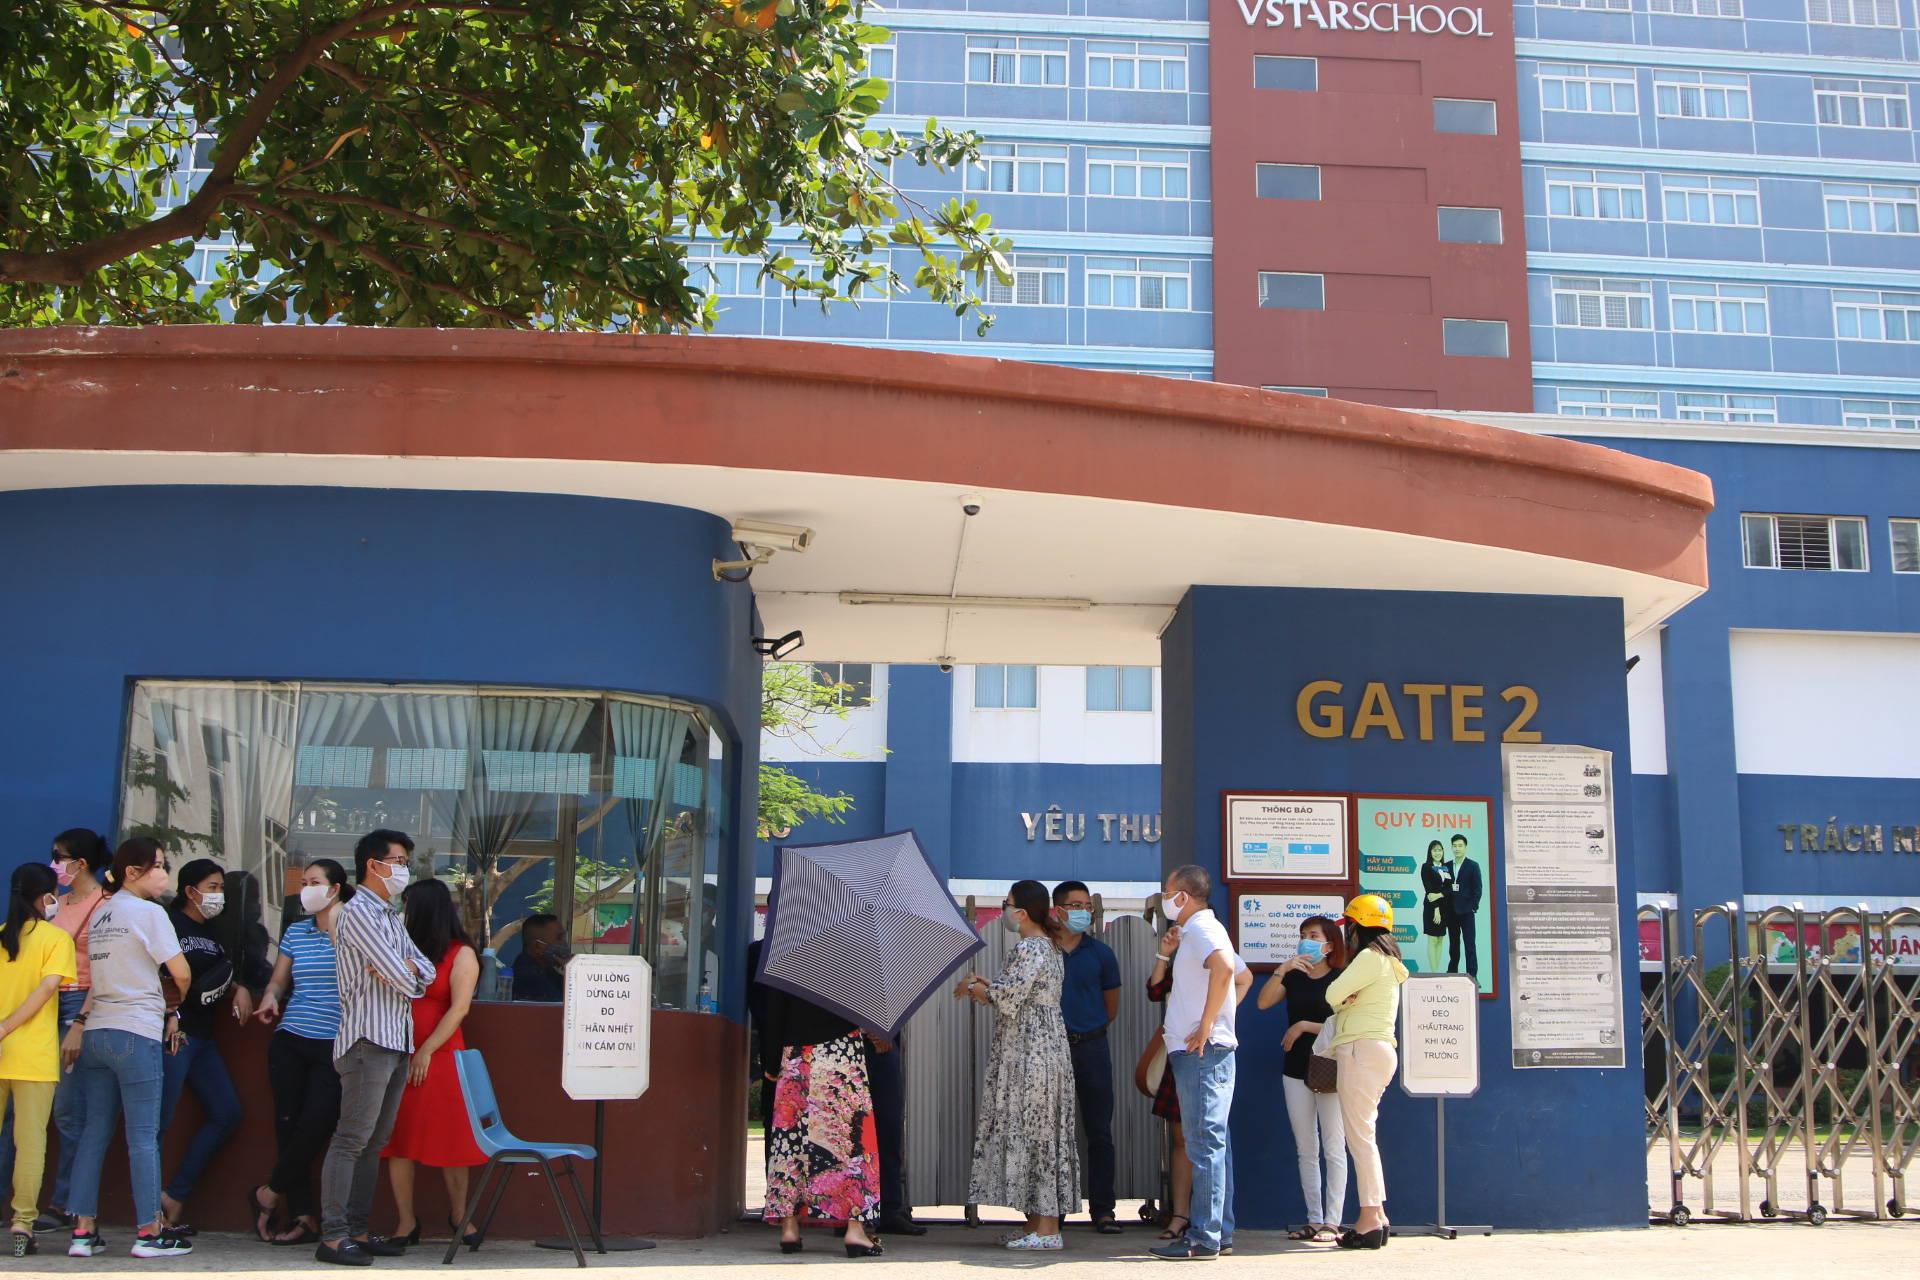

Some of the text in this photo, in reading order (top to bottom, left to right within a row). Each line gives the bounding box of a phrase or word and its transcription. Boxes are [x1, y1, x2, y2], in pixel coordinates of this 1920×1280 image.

[1237, 0, 1494, 37] VSTARSCHOOL
[1296, 680, 1542, 743] GATE 2
[1261, 805, 1313, 814] THÔNG BÁO
[1020, 804, 1086, 842] YÊU
[1375, 811, 1472, 832] QUY ĐỊNH
[1778, 815, 1884, 852] TRÁCH
[1286, 903, 1321, 911] QUY ĐỊNH
[587, 972, 630, 983] VUI LÒNG
[586, 988, 630, 1000] DỪNG LẠI
[601, 1007, 615, 1015] ĐO
[580, 1023, 634, 1035] THÂN NHIỆT
[578, 1042, 592, 1050] XIN
[617, 1042, 635, 1051] ƠN!
[1440, 1037, 1457, 1045] VÀO
[1424, 1051, 1458, 1060] TRƯỜNG
